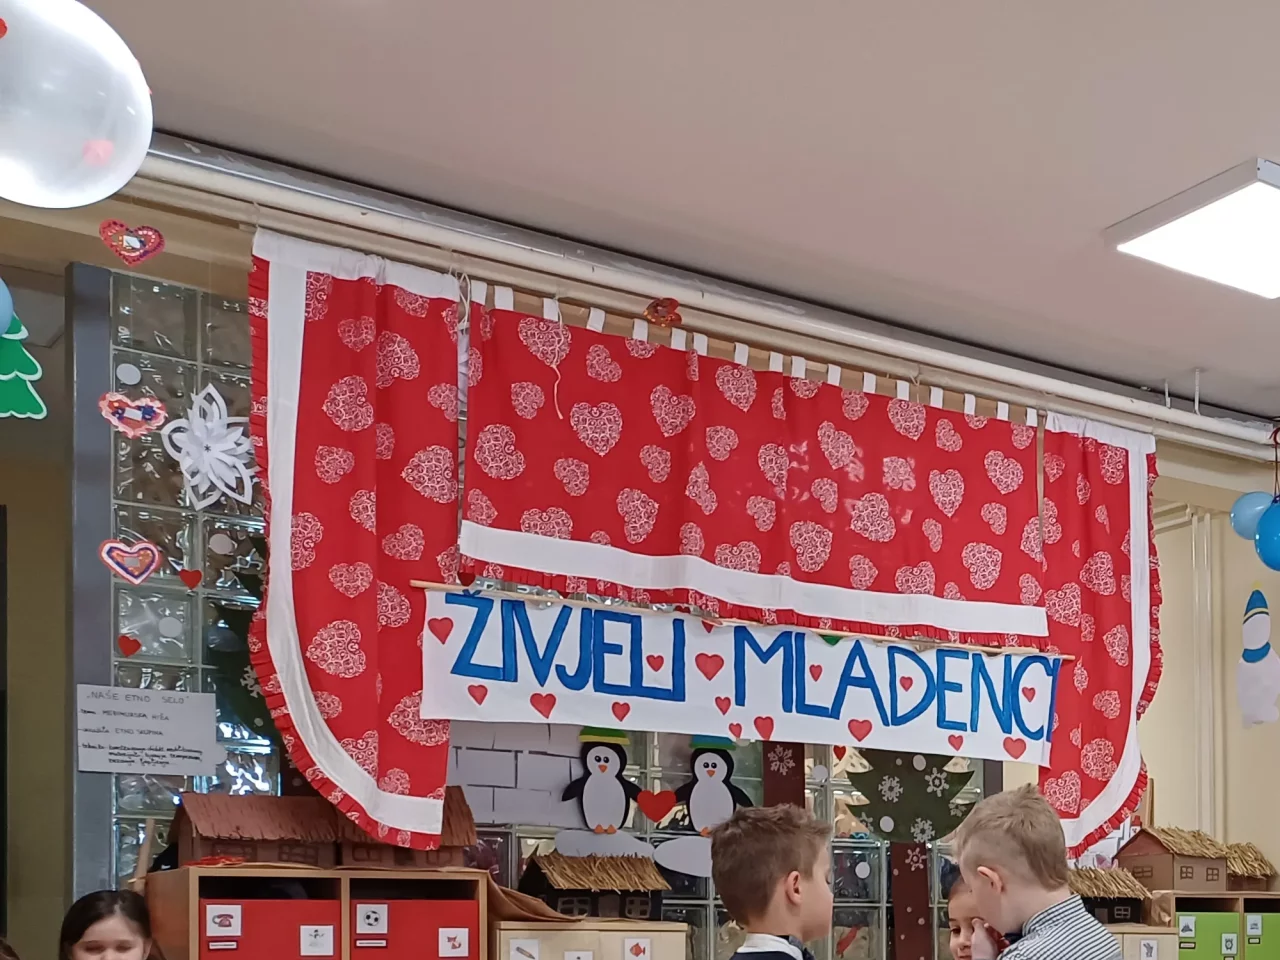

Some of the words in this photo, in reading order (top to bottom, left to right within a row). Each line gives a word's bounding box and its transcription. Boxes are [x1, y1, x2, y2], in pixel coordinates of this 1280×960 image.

[125, 693, 151, 703] ETNO
[445, 589, 686, 702] ŽIVJELI
[732, 625, 1062, 742] MLADENCI
